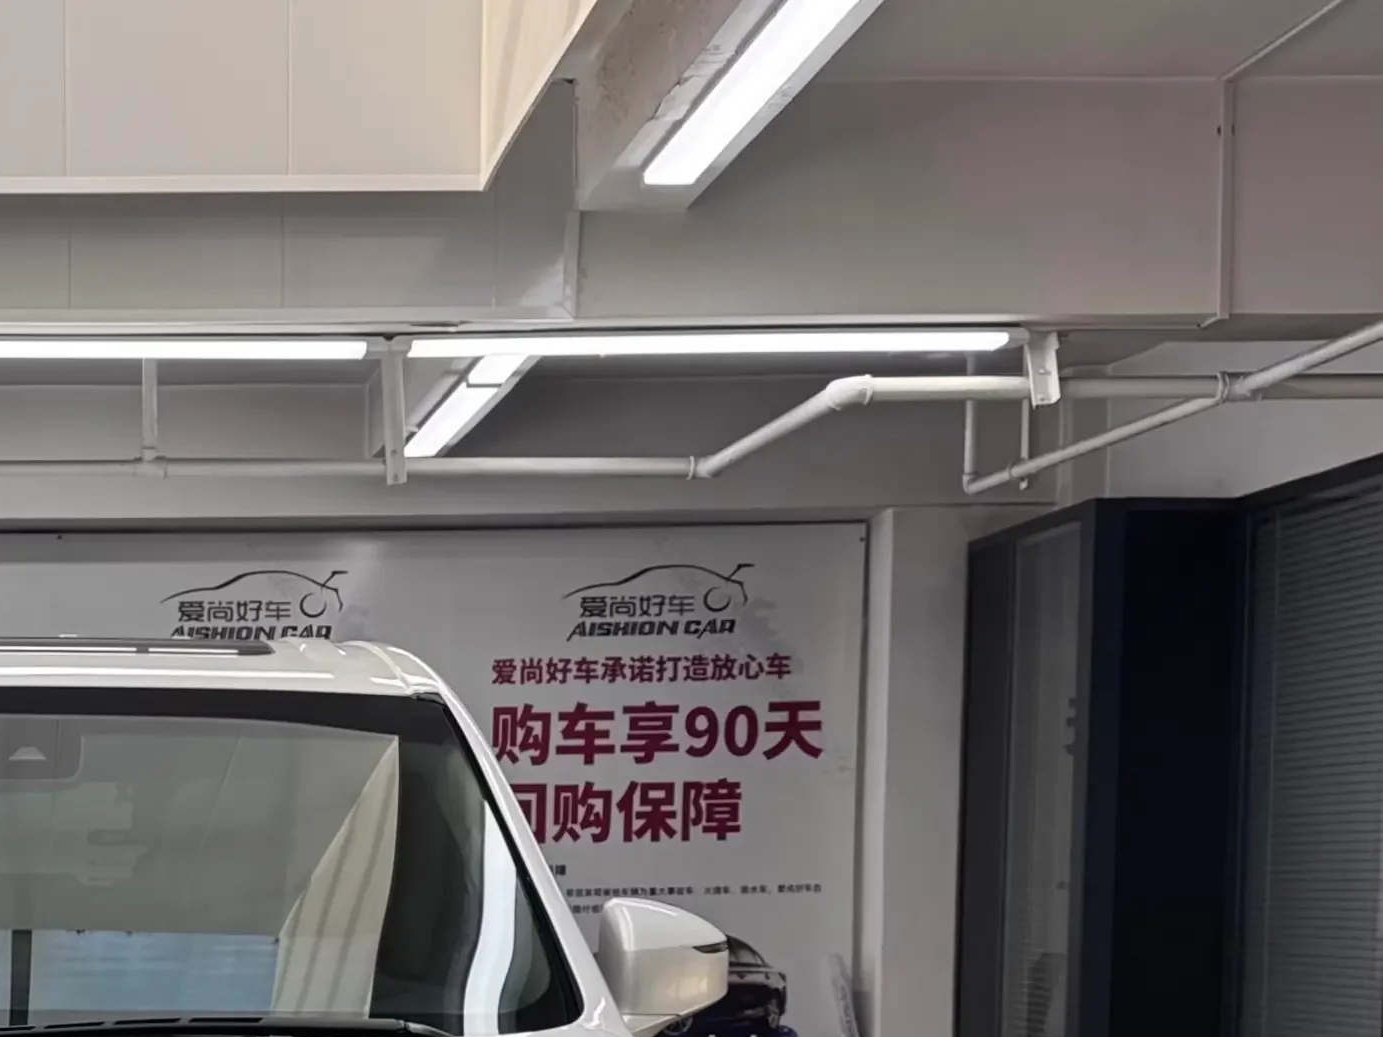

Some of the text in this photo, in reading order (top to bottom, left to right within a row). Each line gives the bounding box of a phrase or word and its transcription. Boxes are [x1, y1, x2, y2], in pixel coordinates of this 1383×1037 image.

[177, 598, 291, 622] 爱尚好车
[579, 594, 696, 618] 爱尚好车
[170, 624, 275, 640] AISHION
[566, 618, 736, 642] AISHION CAR
[491, 652, 793, 685] 爱尚好车承诺打造放心车
[491, 699, 824, 767] 购车享90天
